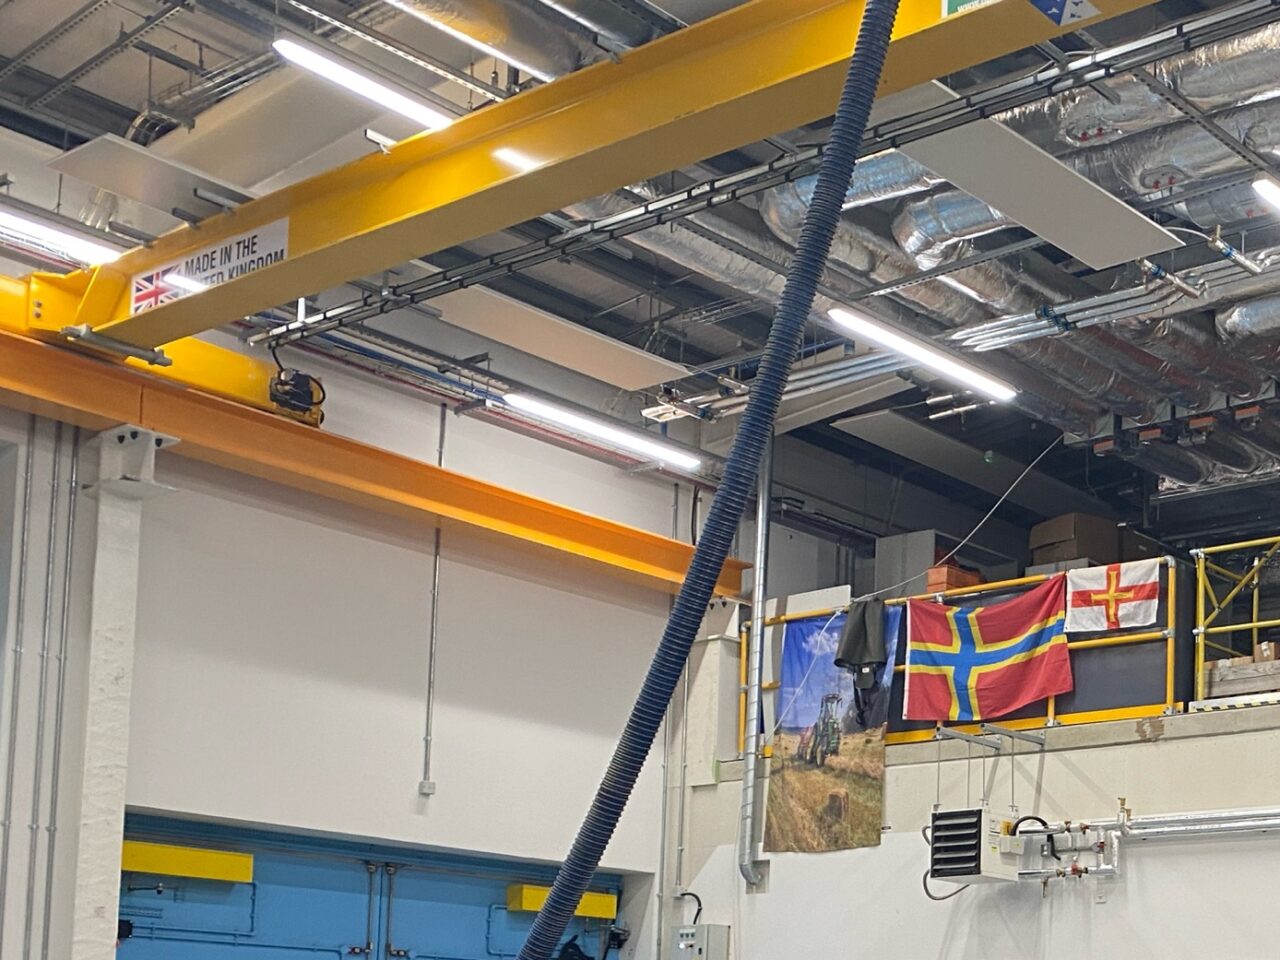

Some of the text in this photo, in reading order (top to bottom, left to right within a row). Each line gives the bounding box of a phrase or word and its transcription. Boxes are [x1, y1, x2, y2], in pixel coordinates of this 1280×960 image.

[185, 235, 258, 276] MADE IN THE
